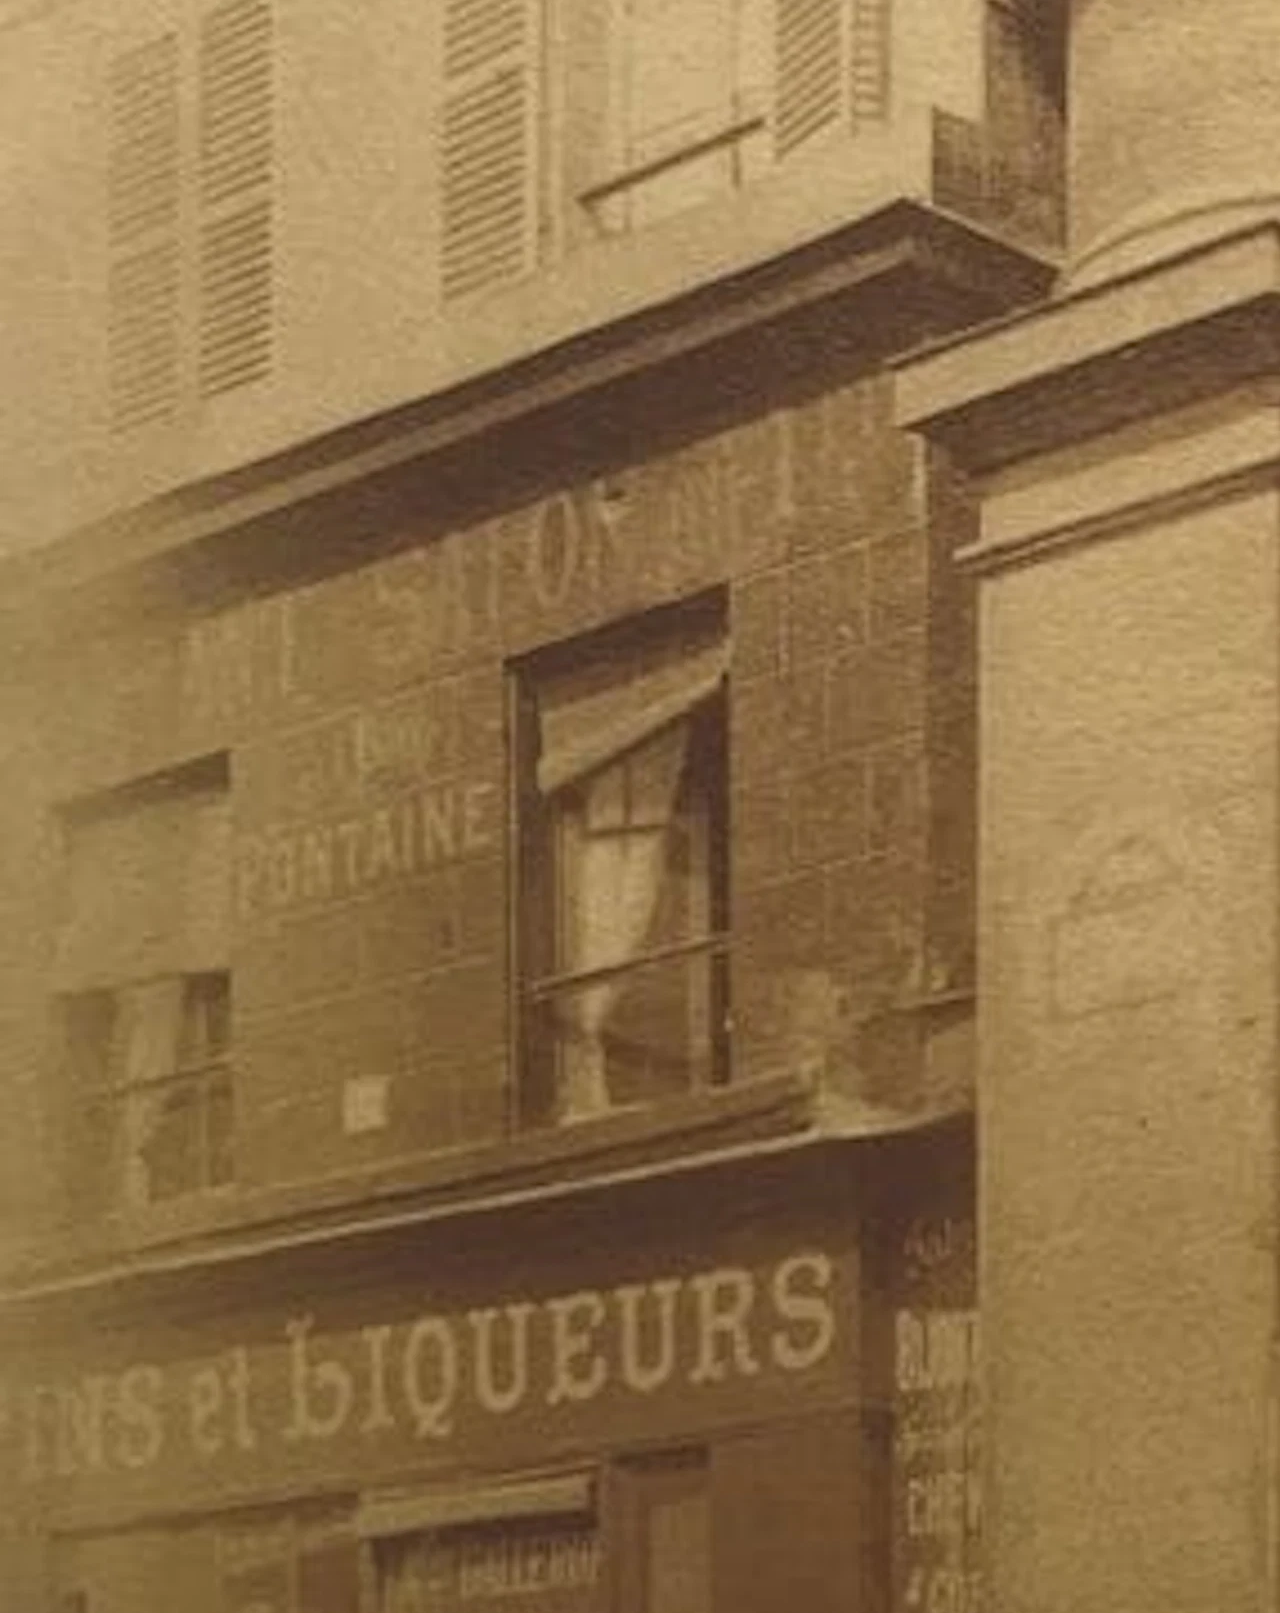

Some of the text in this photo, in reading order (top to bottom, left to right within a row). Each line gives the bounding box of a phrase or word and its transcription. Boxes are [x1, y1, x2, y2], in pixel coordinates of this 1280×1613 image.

[0, 1362, 164, 1485] INS
[189, 1345, 259, 1457] et
[280, 1252, 838, 1440] LIQUEURS
